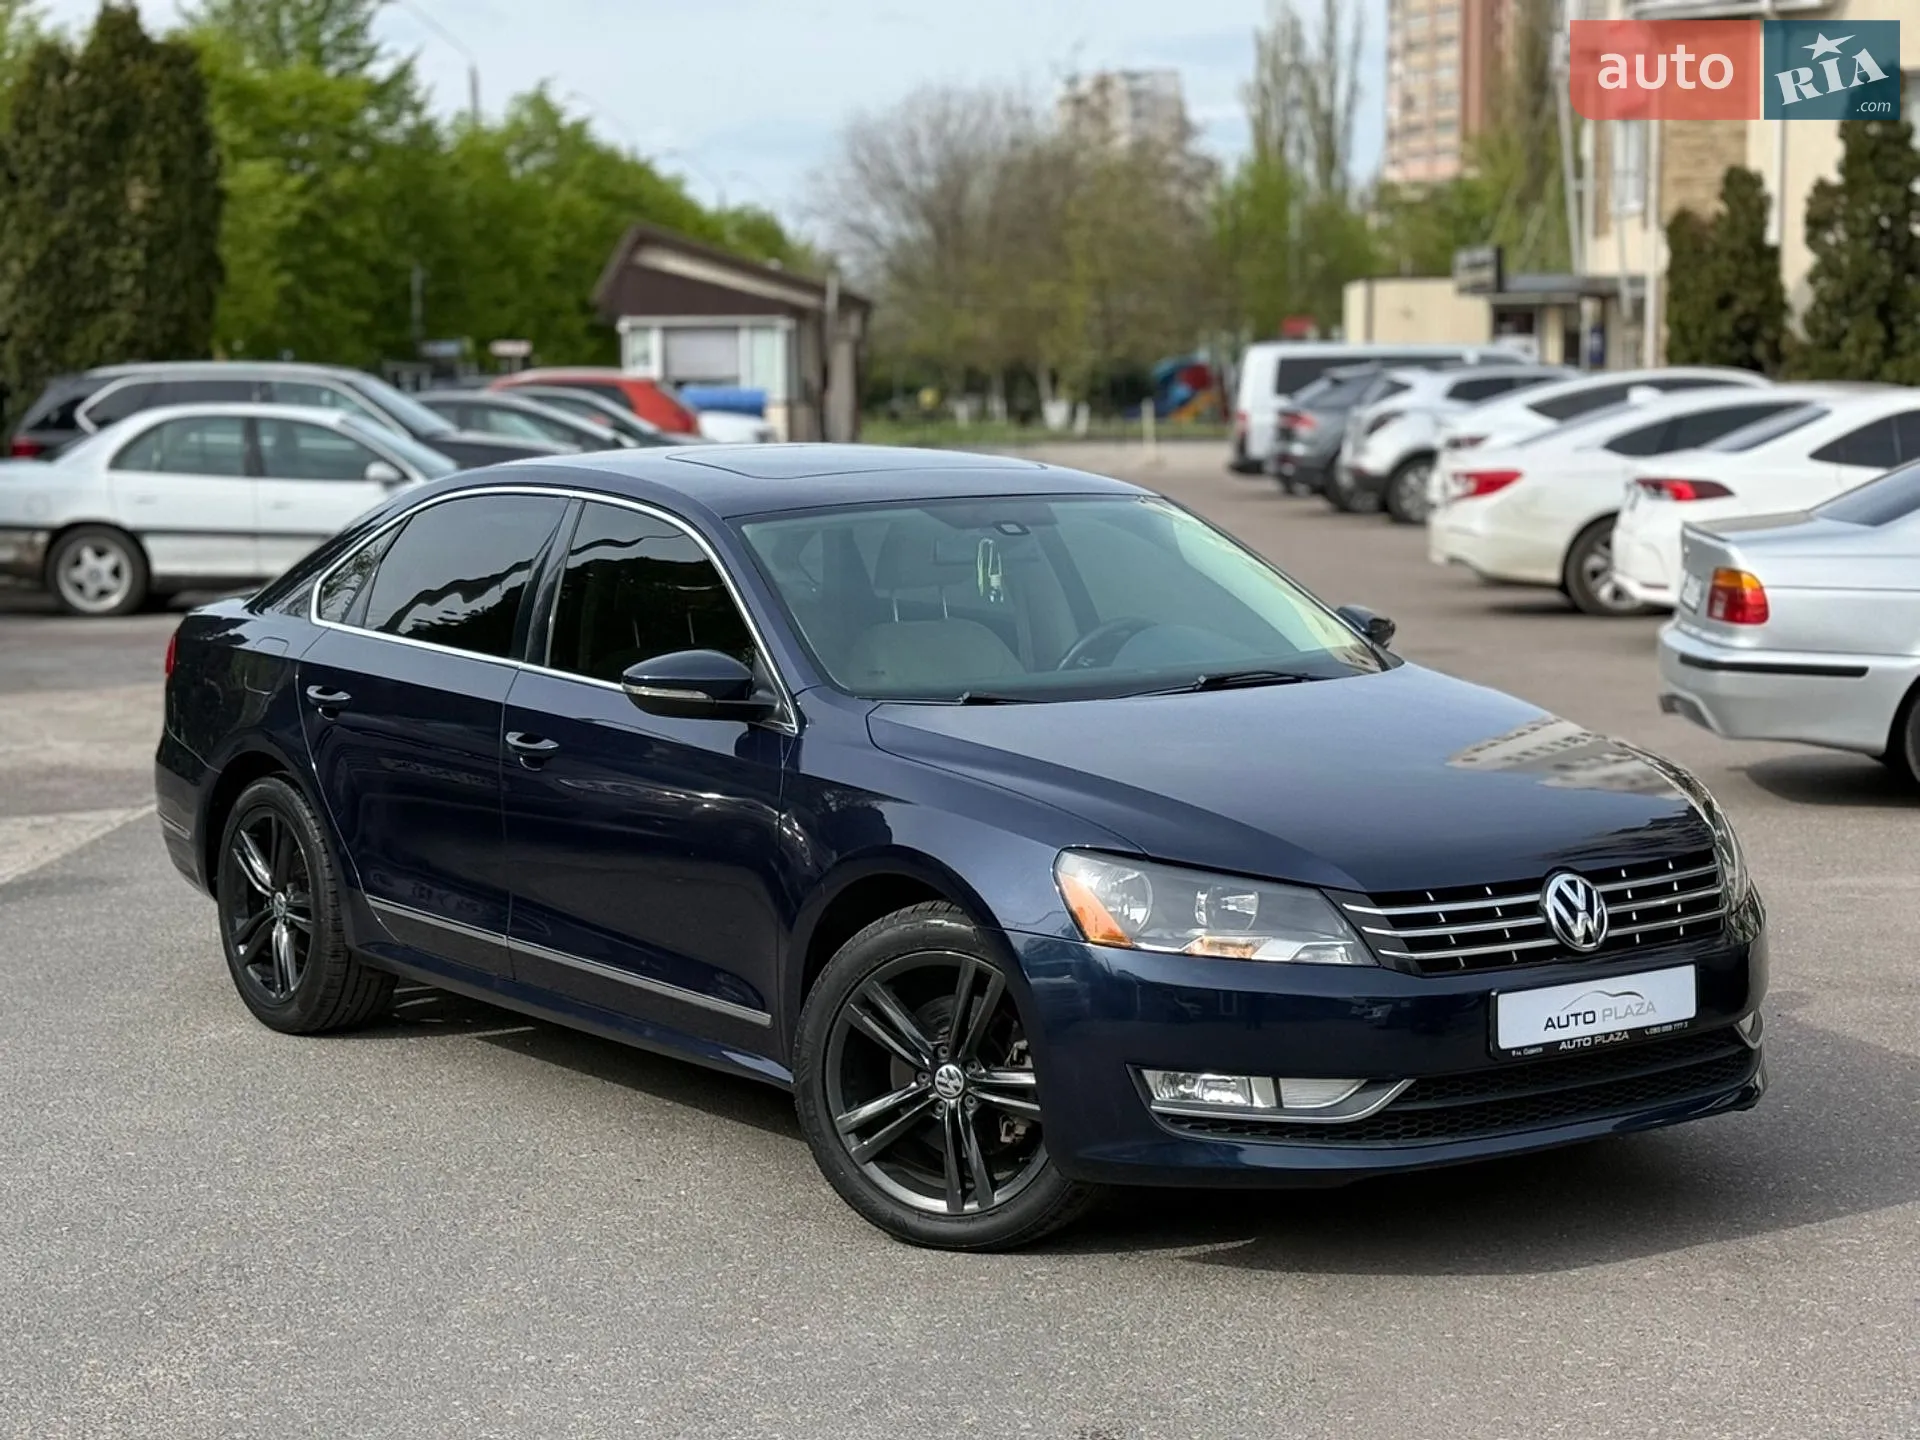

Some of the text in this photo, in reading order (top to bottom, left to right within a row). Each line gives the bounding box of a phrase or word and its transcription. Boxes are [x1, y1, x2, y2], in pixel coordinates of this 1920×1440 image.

[1543, 1001, 1656, 1032] AUTO PLAZA
[1558, 1031, 1629, 1051] AUTO PLAZA
